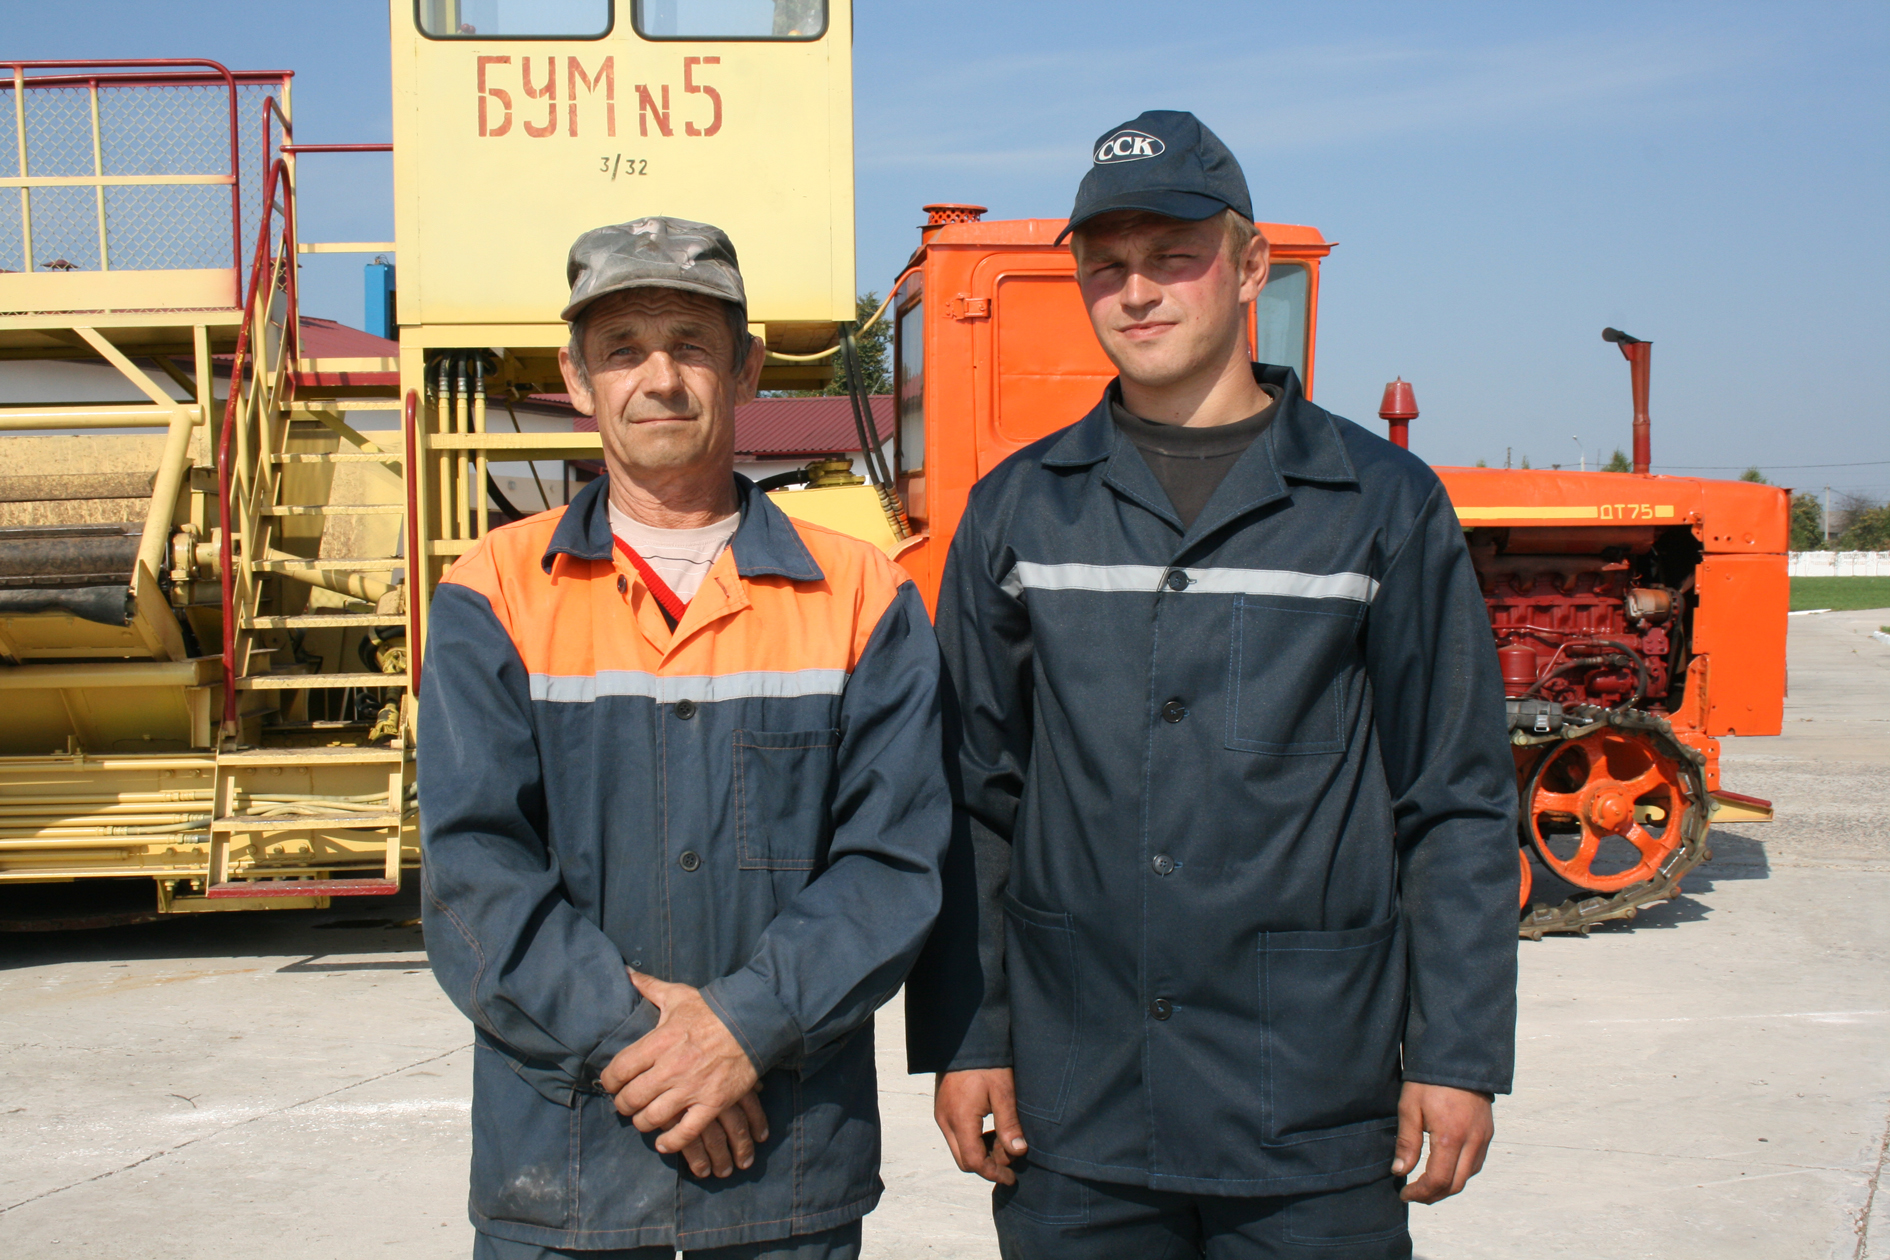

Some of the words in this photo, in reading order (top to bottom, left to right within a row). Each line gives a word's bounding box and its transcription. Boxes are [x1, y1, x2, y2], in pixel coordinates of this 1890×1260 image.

[477, 56, 616, 138] БУМ
[1098, 137, 1155, 161] ССК
[599, 153, 648, 181] 3/32
